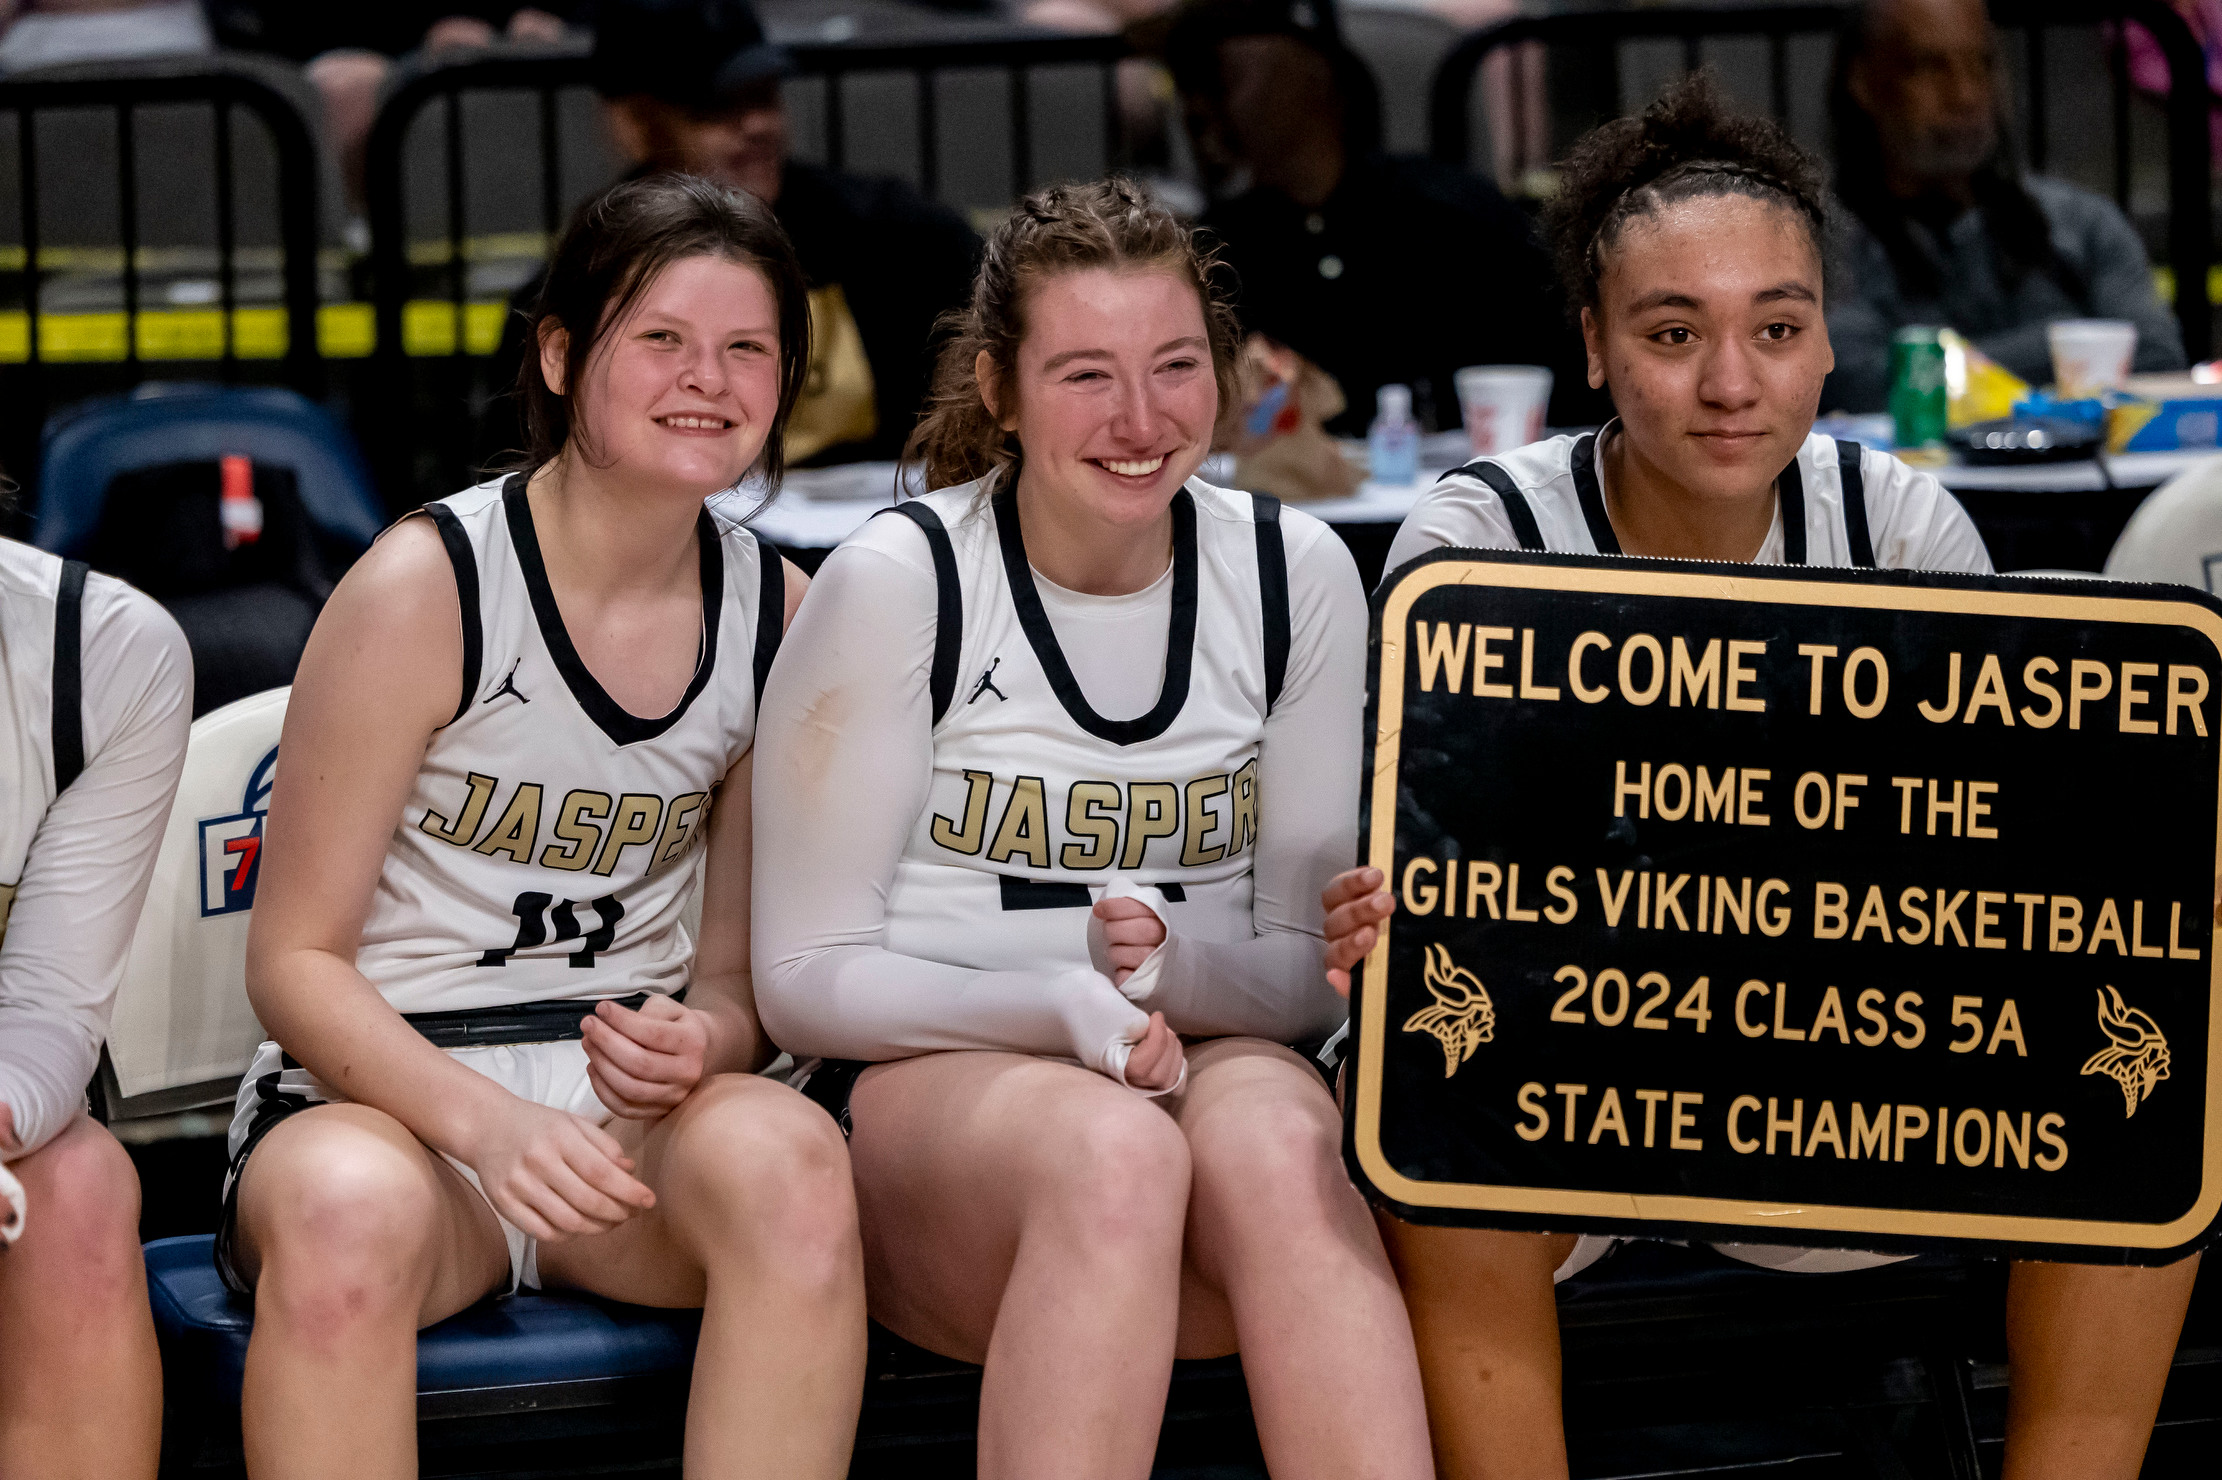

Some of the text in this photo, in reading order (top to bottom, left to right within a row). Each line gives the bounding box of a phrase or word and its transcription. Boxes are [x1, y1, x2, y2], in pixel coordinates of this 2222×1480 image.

[1414, 618, 2211, 738] WELCOME TO JASPER
[930, 757, 1257, 871] JASPER
[1612, 759, 2000, 840] HOME OF THE
[1401, 855, 2202, 961] GIRLS VIKING BASKETBALL
[1549, 963, 2029, 1058] 2024 CLASS 5A
[1513, 1080, 2070, 1173] STATE CHAMPIONS
